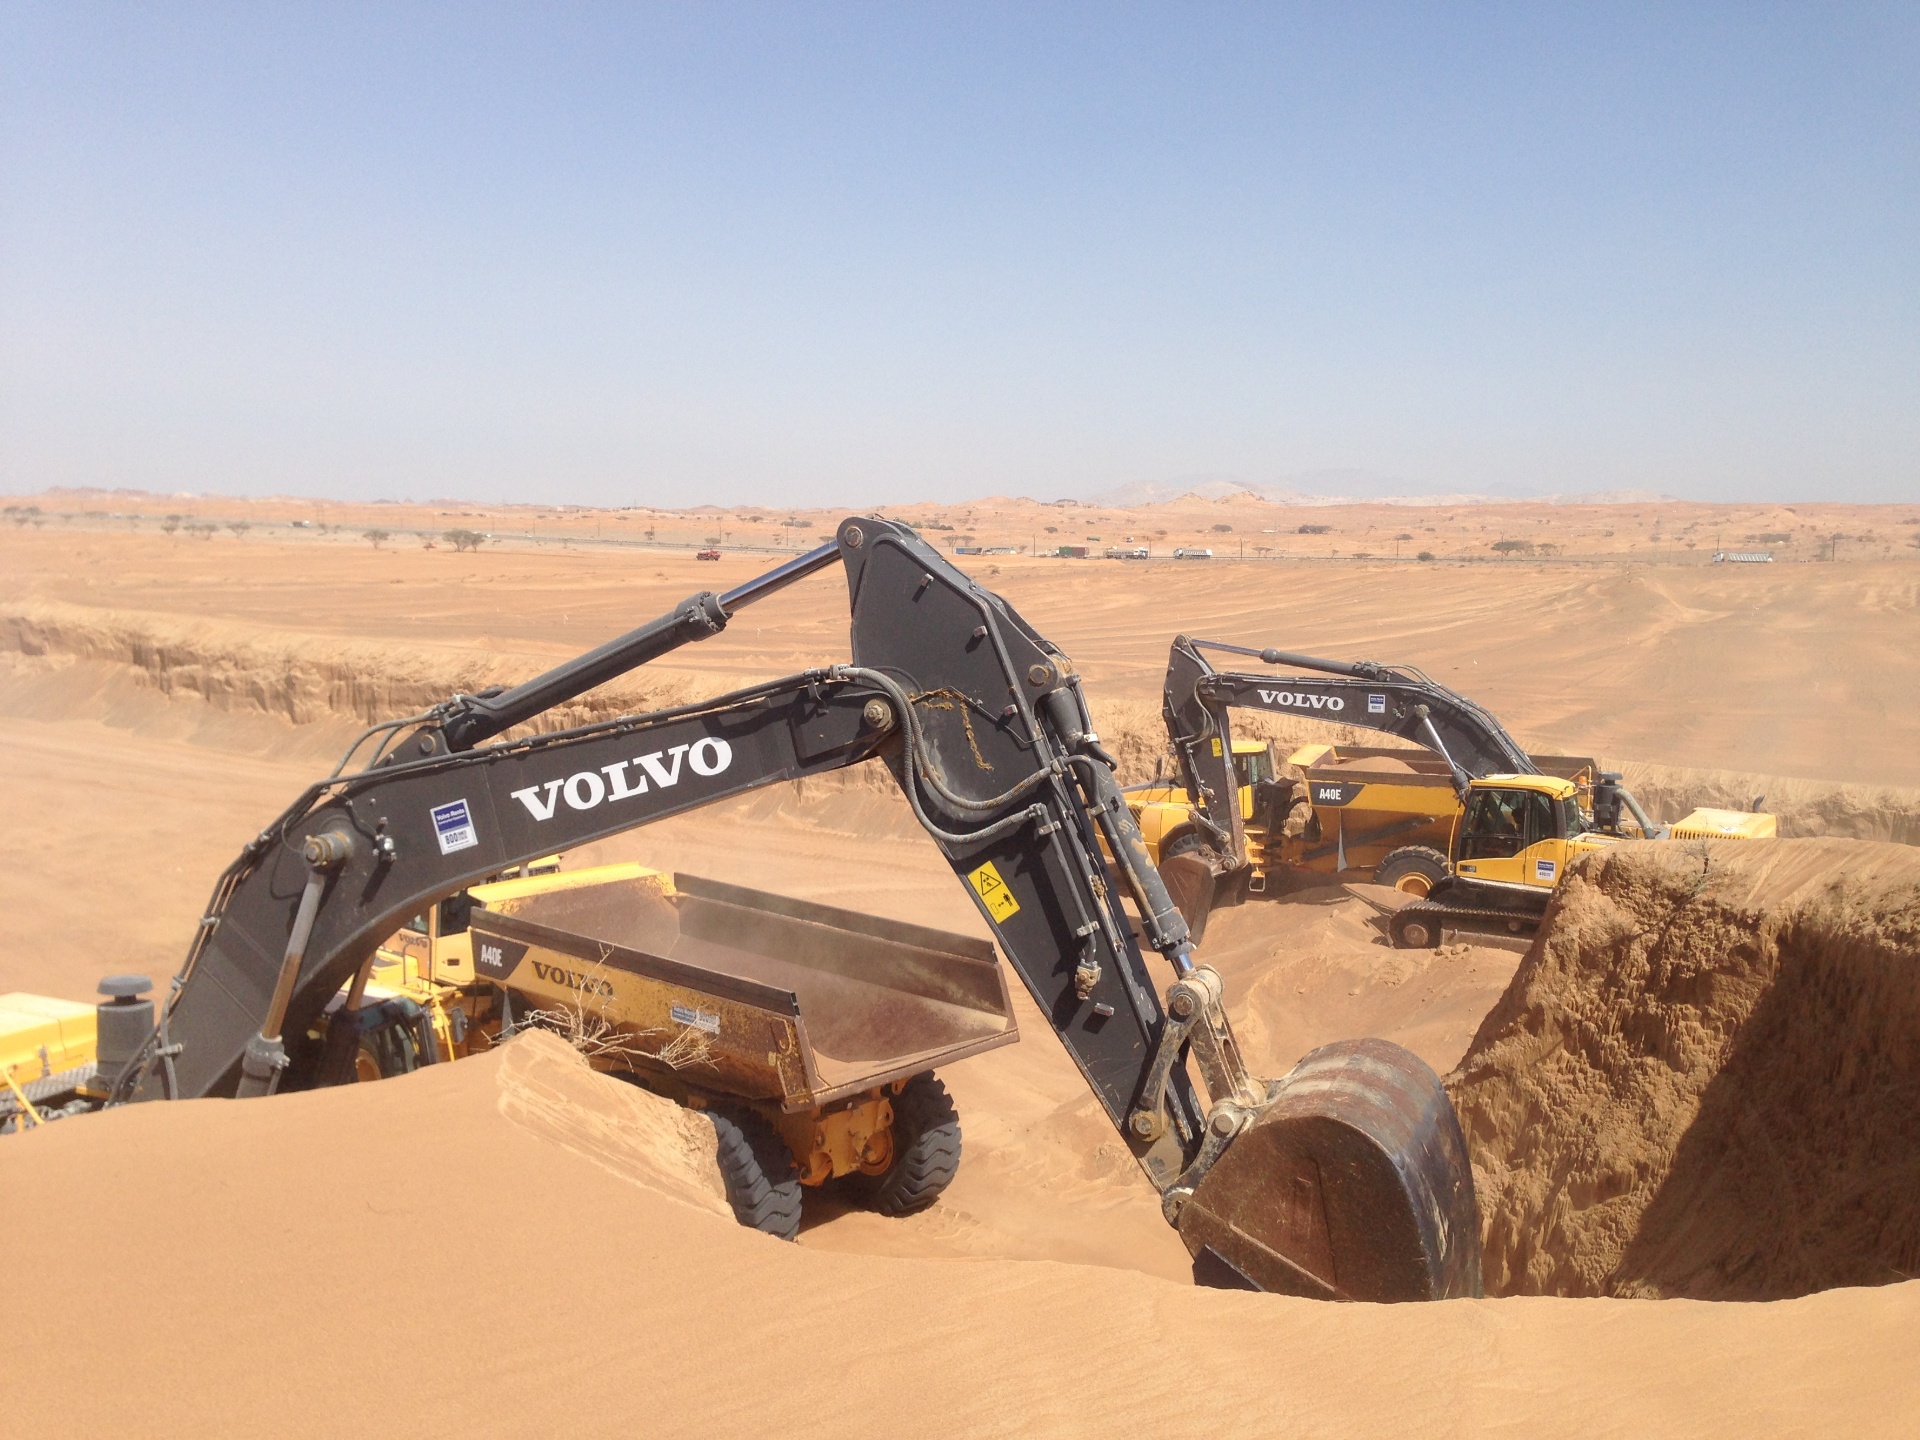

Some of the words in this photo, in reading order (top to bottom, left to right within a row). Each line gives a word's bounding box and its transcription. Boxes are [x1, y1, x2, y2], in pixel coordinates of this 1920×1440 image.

[1257, 689, 1345, 711] VOLVO
[511, 736, 733, 821] VOLVO
[1319, 788, 1342, 800] A40E
[481, 944, 503, 967] A40E
